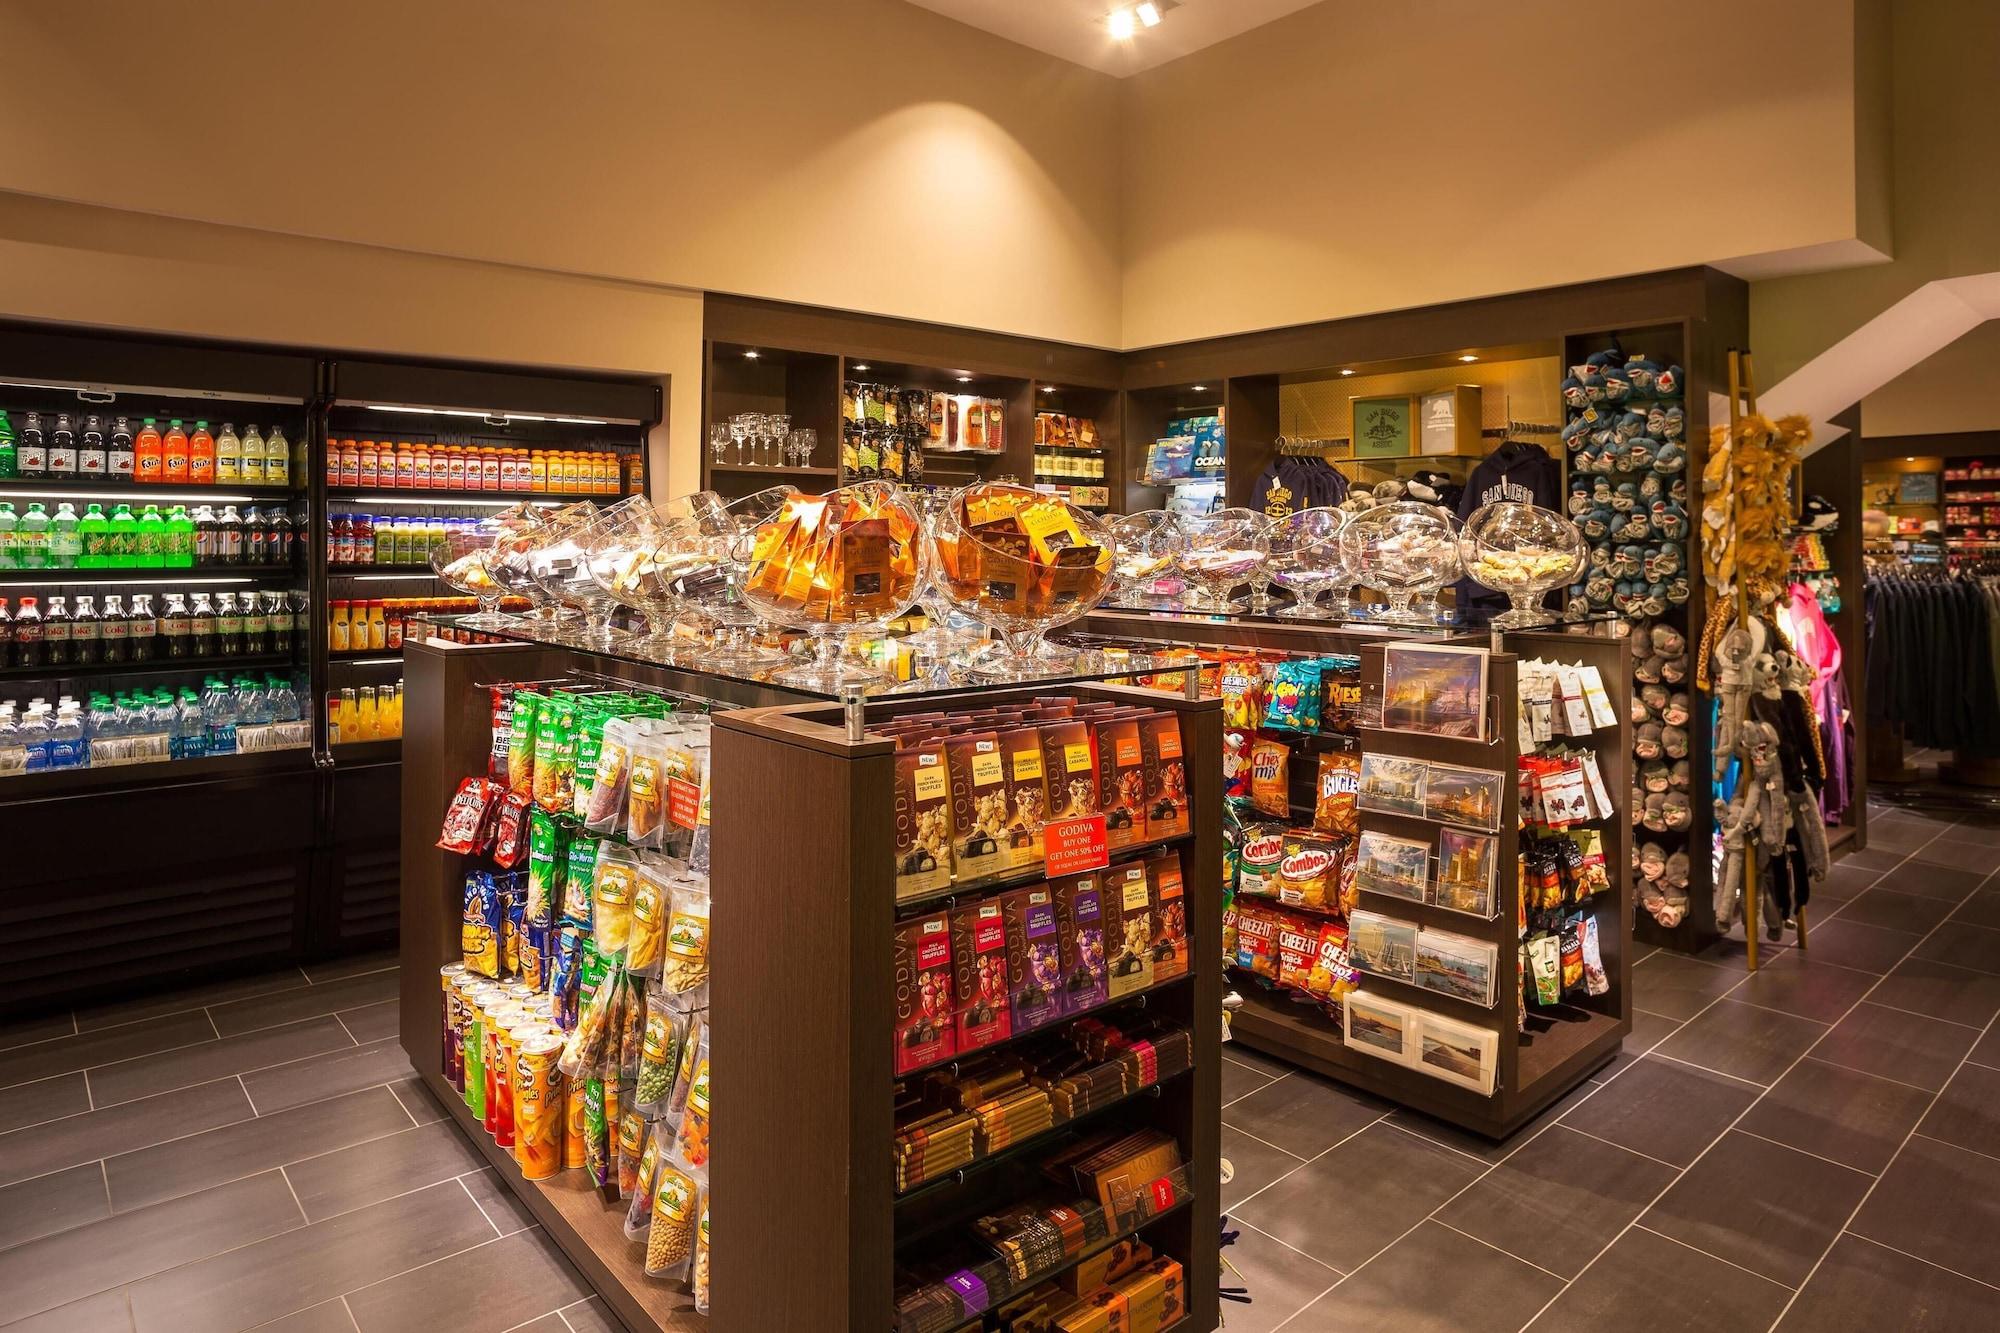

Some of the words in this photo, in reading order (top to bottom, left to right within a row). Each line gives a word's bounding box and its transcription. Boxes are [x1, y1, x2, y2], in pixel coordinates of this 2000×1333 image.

[1253, 752, 1281, 767] Chex
[977, 769, 999, 777] TRUFFLES
[1045, 735, 1064, 814] GODIVA
[1100, 730, 1113, 806] GODIVA
[920, 783, 942, 792] TRUFFLES
[951, 746, 970, 831] GODIVA
[895, 759, 910, 848] GODIVA
[1058, 823, 1094, 838] GODIVA
[1063, 838, 1076, 848] BUY
[1077, 836, 1091, 846] ONE
[1050, 850, 1063, 861] GET
[1064, 848, 1079, 859] ONE
[1093, 844, 1105, 854] OFF
[1281, 853, 1327, 875] Combos
[1078, 906, 1098, 915] TRUFFLES
[1030, 919, 1052, 929] TRUFFLES
[1056, 887, 1073, 968] GODIVA
[979, 929, 1001, 938] CHOCOLATE
[979, 934, 1001, 943] TRUFFLES
[1005, 900, 1022, 983] GODIVA
[1279, 932, 1318, 956] CHEEZ-IT
[922, 945, 946, 955] CHOCOLATE
[922, 950, 946, 960] TRUFFLES
[955, 913, 972, 1000] GODIVA
[1281, 951, 1304, 966] Snack
[895, 930, 912, 1019] GODIVA
[1282, 961, 1297, 974] Mix
